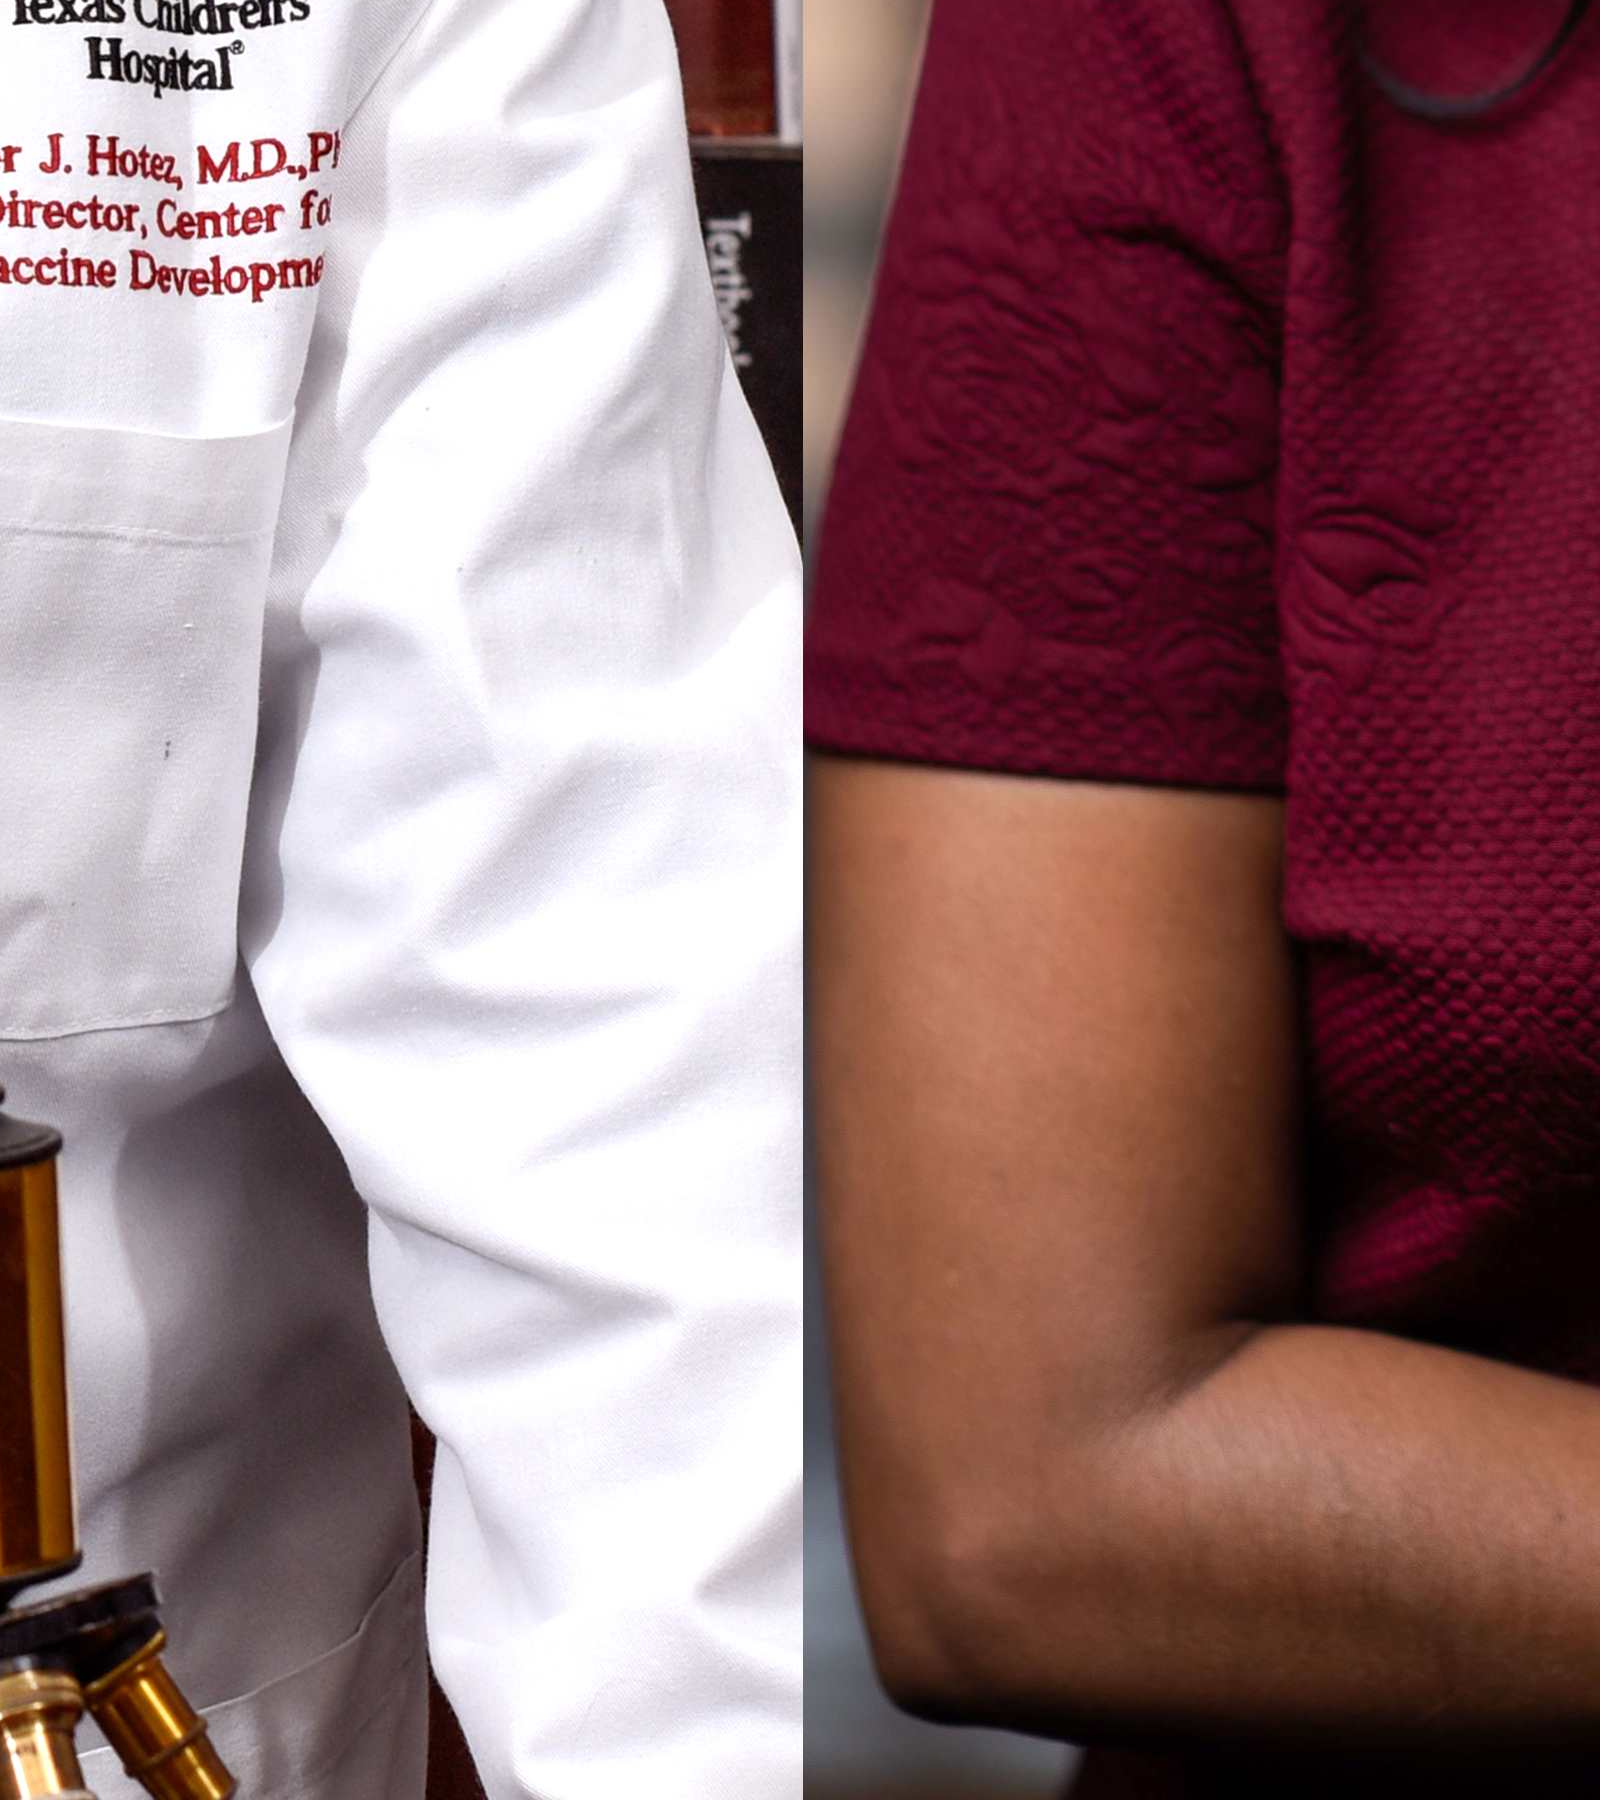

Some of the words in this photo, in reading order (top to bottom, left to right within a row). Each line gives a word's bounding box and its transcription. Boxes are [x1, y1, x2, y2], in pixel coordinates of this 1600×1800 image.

[39, 133, 73, 175] J.
[87, 134, 183, 191] Hotez,
[156, 198, 285, 240] Center
[300, 188, 332, 230] fo
